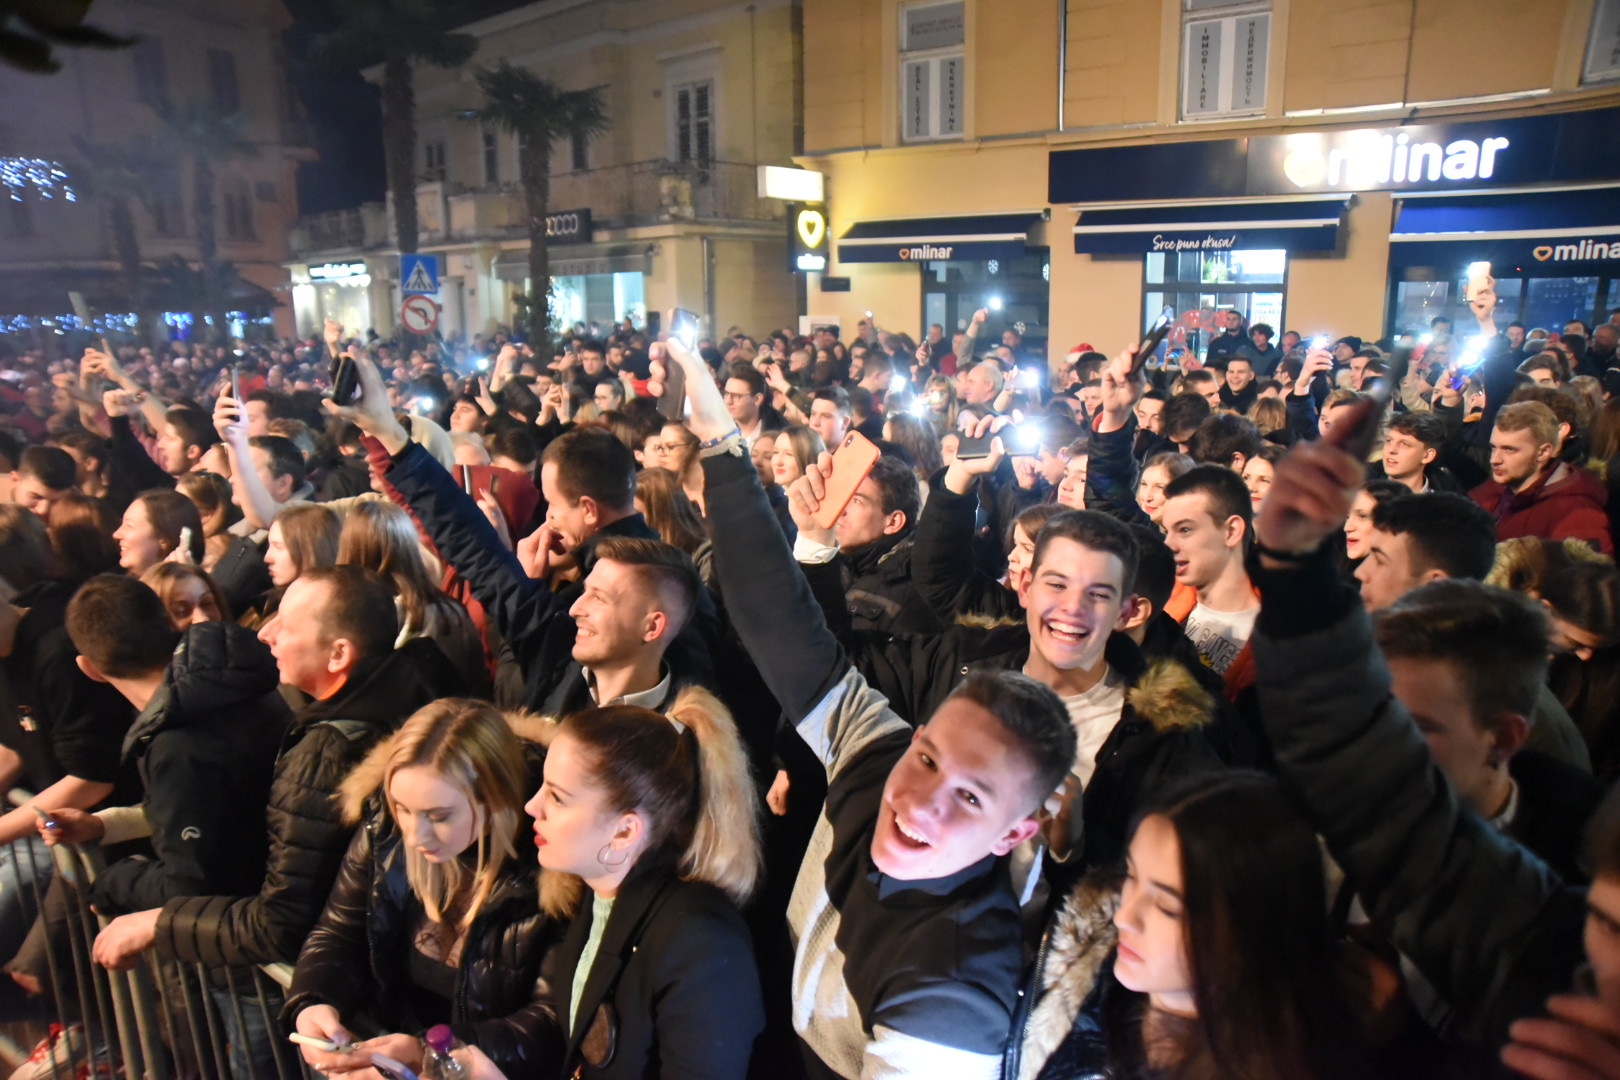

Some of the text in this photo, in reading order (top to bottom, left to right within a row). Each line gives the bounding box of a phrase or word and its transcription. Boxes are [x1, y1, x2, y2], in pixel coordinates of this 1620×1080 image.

[1200, 27, 1209, 108] IMMOBILIARE
[1153, 234, 1176, 251] Srce
[1201, 234, 1236, 248] okusa!
[910, 244, 953, 260] mlinar
